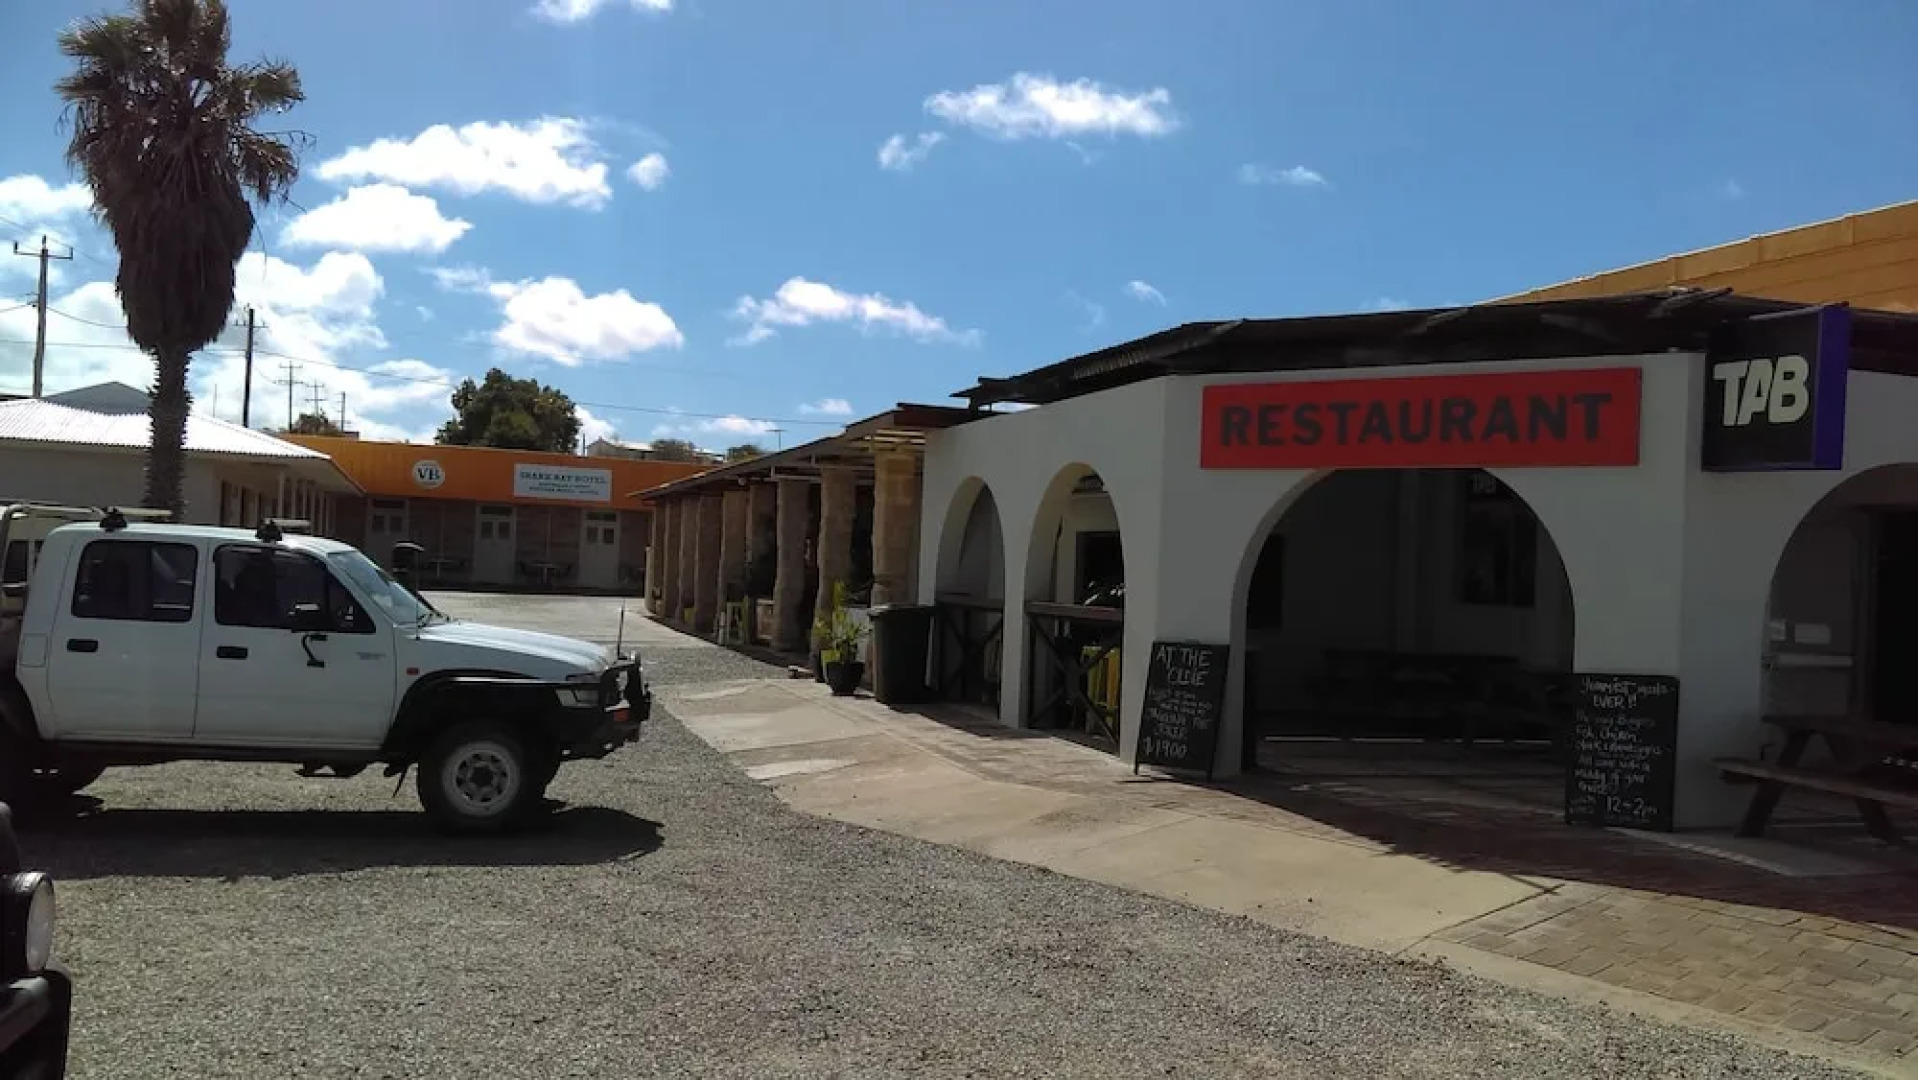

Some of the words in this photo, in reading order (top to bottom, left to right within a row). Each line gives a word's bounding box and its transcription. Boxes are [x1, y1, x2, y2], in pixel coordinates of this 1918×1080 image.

[1713, 355, 1809, 427] TAB
[1220, 392, 1612, 446] RESTAURANT
[417, 466, 440, 480] VB
[520, 471, 553, 480] SHARK
[554, 473, 573, 482] BAY
[575, 475, 608, 484] HOTEL
[1156, 644, 1176, 669] AT
[1179, 646, 1213, 668] THE
